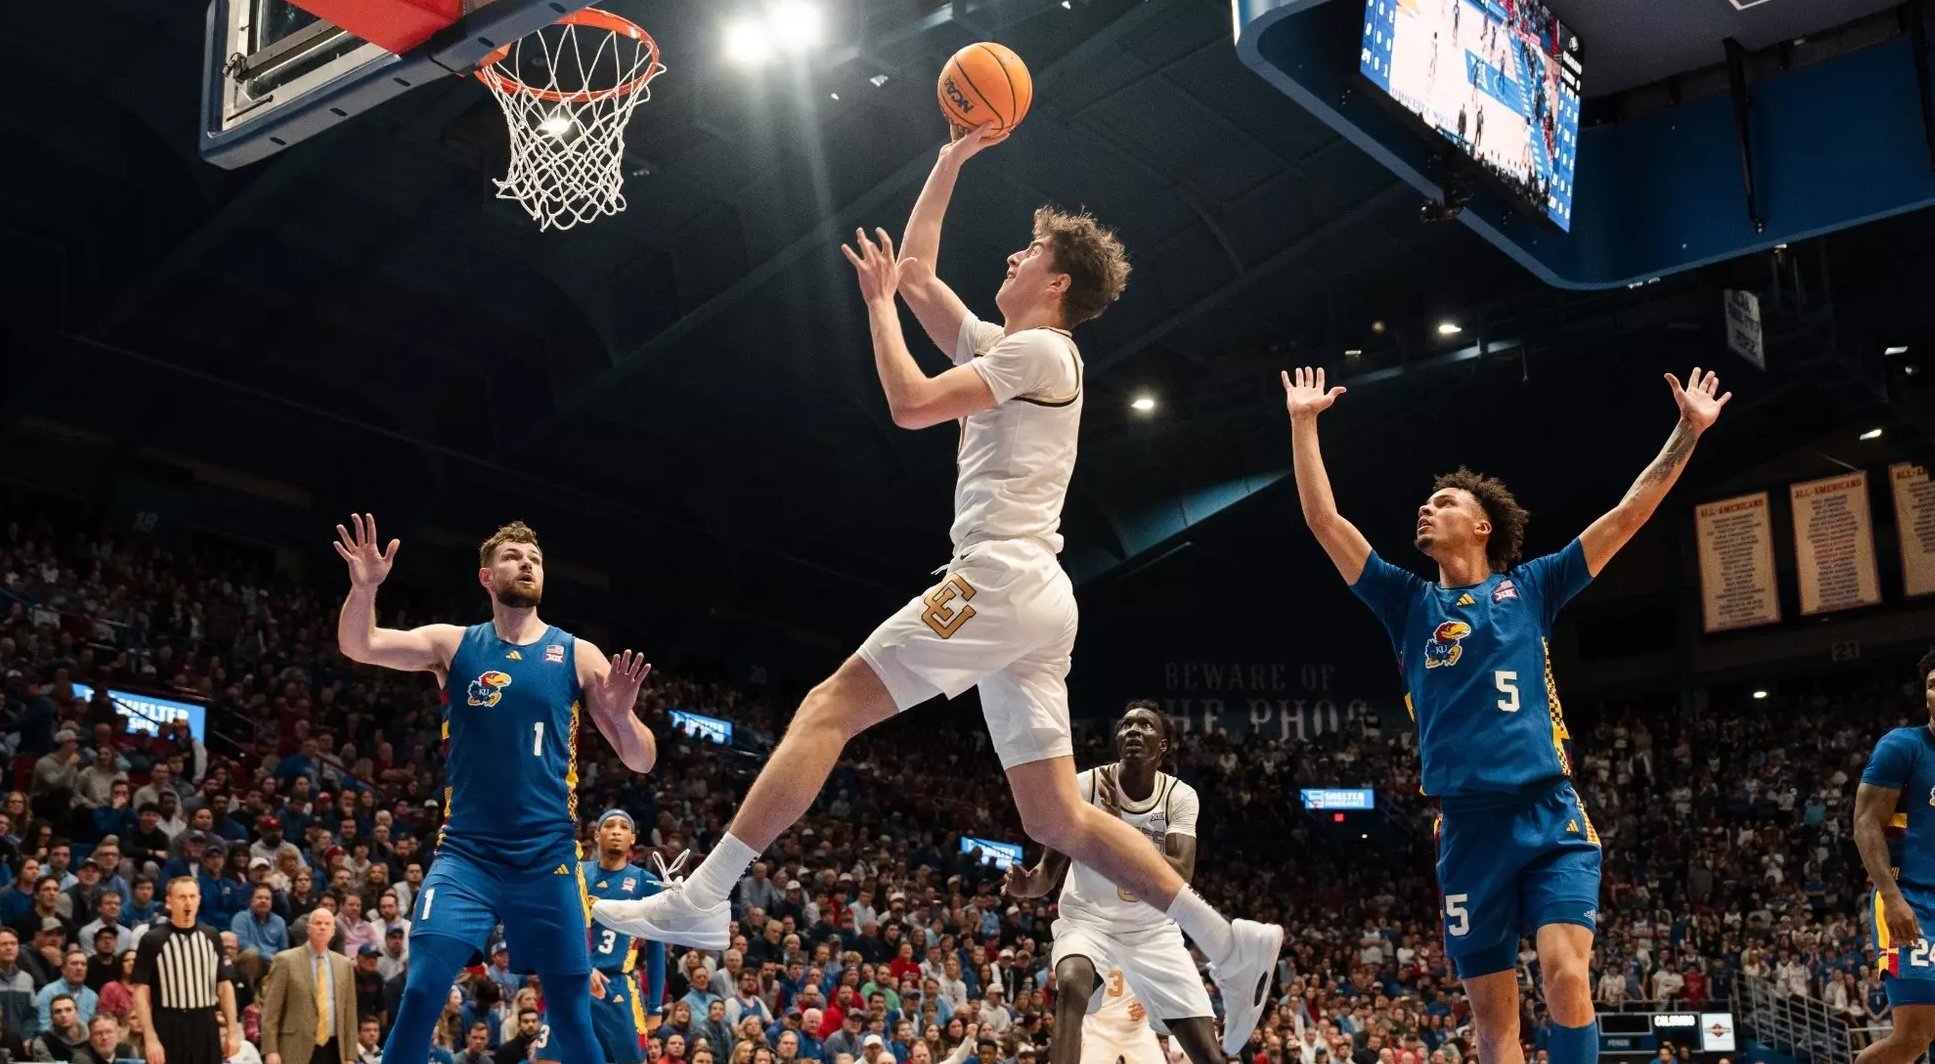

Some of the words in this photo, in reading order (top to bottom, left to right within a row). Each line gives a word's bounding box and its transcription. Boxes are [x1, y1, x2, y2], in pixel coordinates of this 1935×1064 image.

[1794, 478, 1862, 499] ALL-AMERICANS
[1700, 499, 1764, 517] ALL-AMERICANS
[1435, 644, 1449, 654] KU
[1164, 662, 1287, 691] BEWARE
[1300, 663, 1336, 691] OF
[478, 688, 490, 696] KU
[1495, 670, 1520, 712] 5
[1163, 697, 1225, 735] HE
[534, 722, 544, 757] 1
[421, 887, 434, 920] 1
[1445, 894, 1470, 936] 5
[598, 930, 616, 954] 3
[1108, 969, 1124, 996] 3
